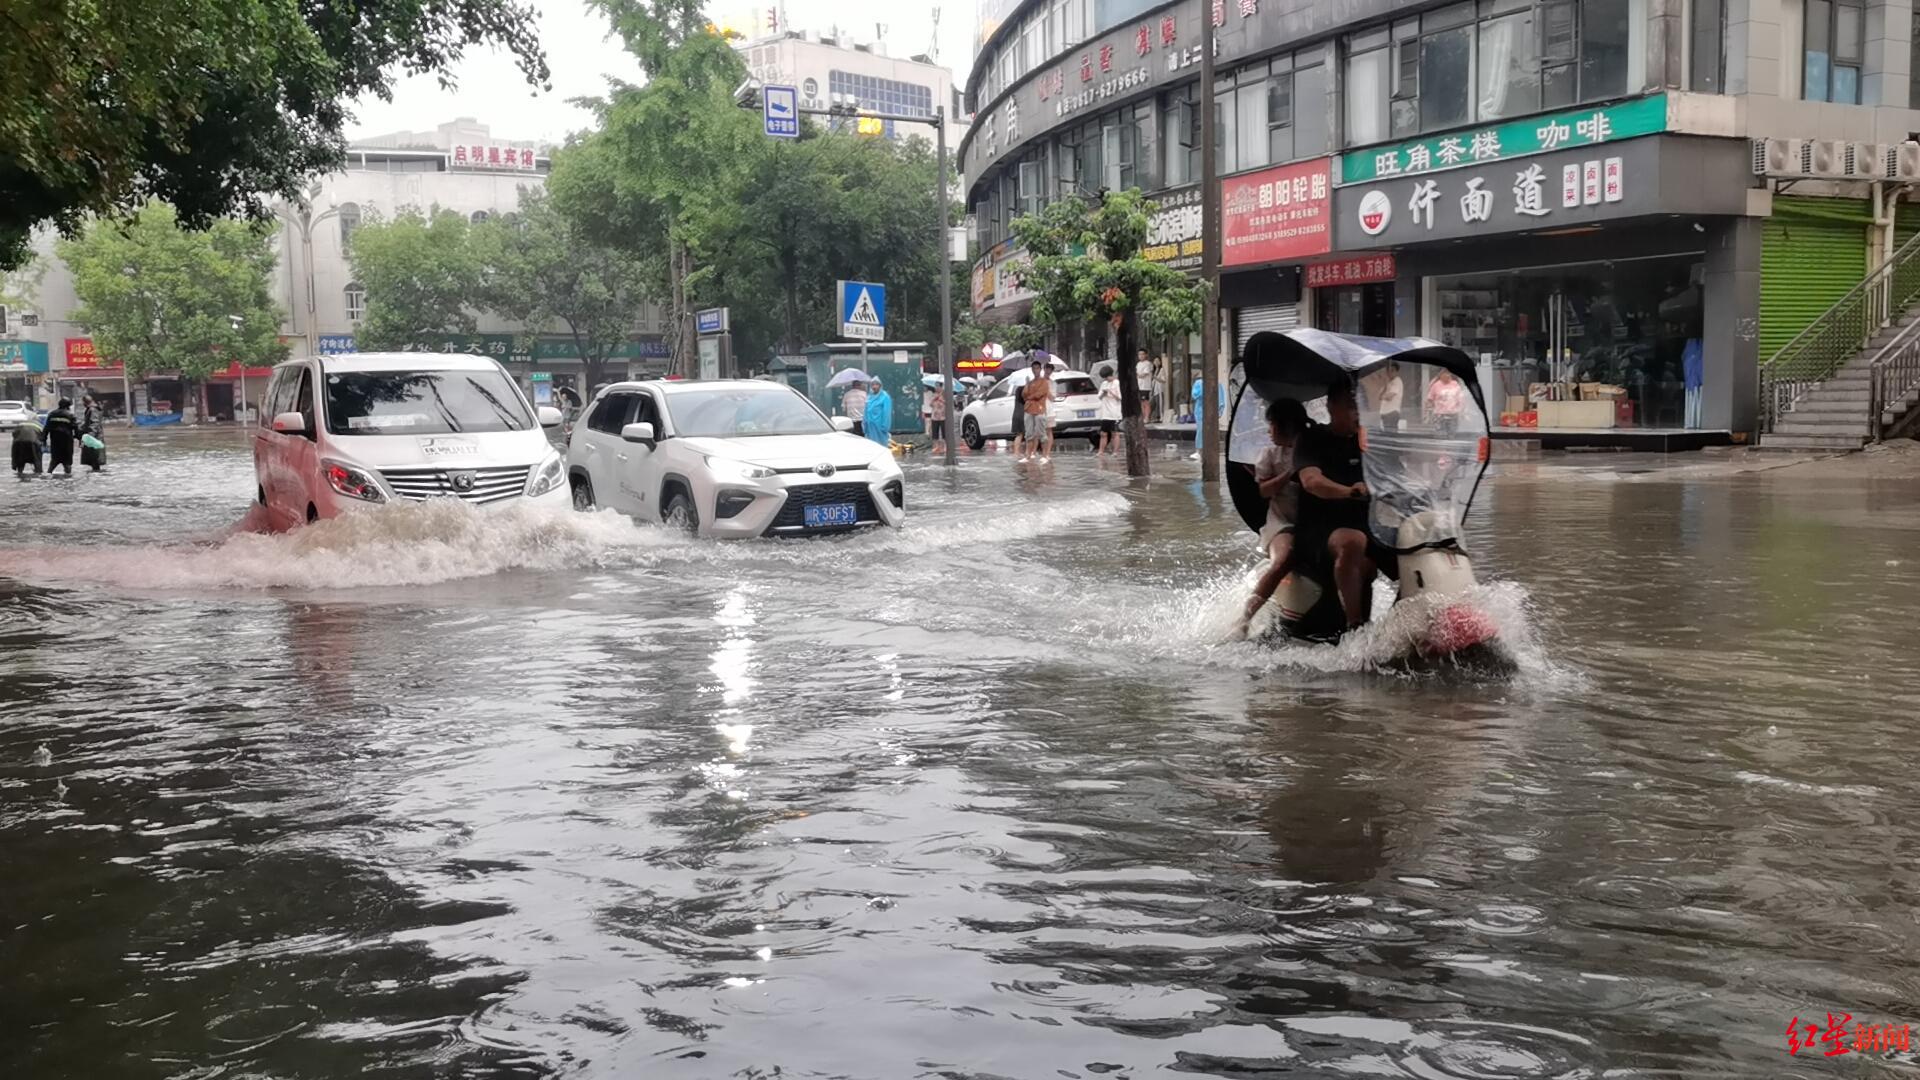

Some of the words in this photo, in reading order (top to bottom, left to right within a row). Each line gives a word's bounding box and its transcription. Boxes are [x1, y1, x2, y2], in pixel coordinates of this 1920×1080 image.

[1168, 37, 1217, 71] 请上二
[455, 145, 534, 166] 启明星宾馆
[1375, 131, 1502, 176] 旺角茶楼
[1536, 112, 1612, 149] 咖啡
[1259, 173, 1327, 208] 朝阳轮胎
[1408, 163, 1552, 230] 仟面道
[1565, 170, 1576, 201] 凉菜
[1586, 166, 1597, 198] 卤菜
